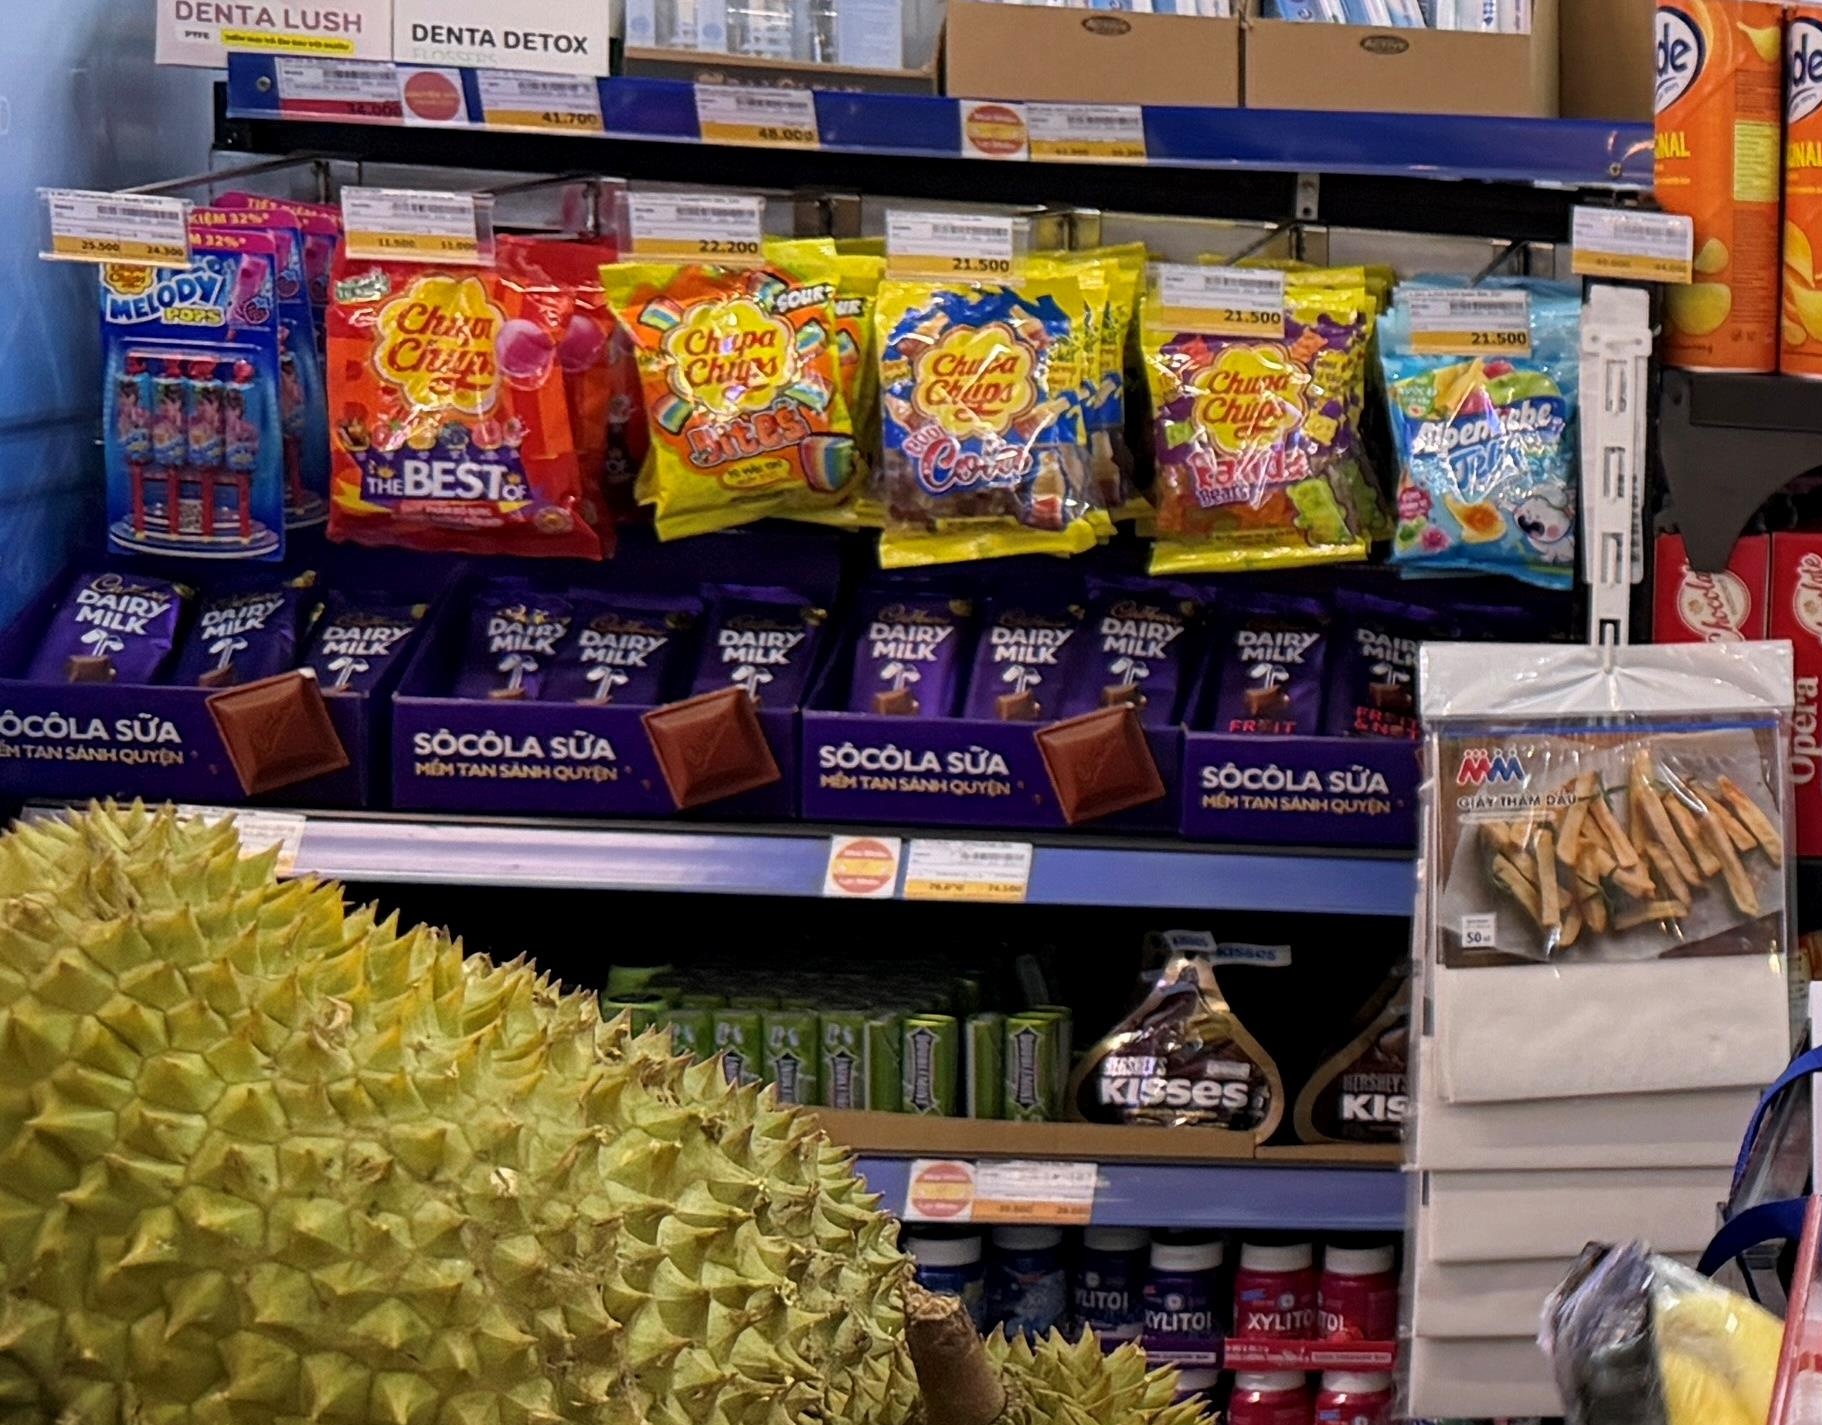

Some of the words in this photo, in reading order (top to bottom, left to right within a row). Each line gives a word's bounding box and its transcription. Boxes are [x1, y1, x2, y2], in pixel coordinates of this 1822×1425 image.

[284, 7, 364, 34] LUSH
[411, 23, 496, 48] DENTA
[502, 28, 588, 54] DETOX
[699, 240, 759, 255] 22.200
[952, 257, 1011, 273] 21.500
[106, 274, 224, 323] MELODY
[165, 307, 224, 326] POPS
[1223, 308, 1282, 326] 21.500
[684, 328, 776, 356] Chupa
[1470, 330, 1528, 347] 21.500
[686, 356, 779, 388] Chups
[932, 353, 1019, 378] Chupa
[925, 378, 1016, 407] Chups
[1207, 369, 1289, 398] Chupa
[367, 477, 404, 496] THE
[402, 459, 508, 500] BEST
[502, 484, 528, 501] OF
[75, 588, 172, 624] DAIRY
[201, 595, 286, 628] DAIRY
[75, 607, 150, 636] MILK
[201, 615, 266, 640] MILK
[488, 616, 569, 640] DAIRY
[1100, 616, 1185, 643] DAIRY
[323, 624, 416, 643] DAIRY
[578, 628, 669, 653] DAIRY
[718, 628, 806, 649] DAIRY
[868, 621, 955, 645] DAIRY
[990, 626, 1075, 648] DAIRY
[1236, 629, 1321, 649] DAIRY
[322, 639, 391, 656] MILK
[489, 635, 558, 656] MILK
[721, 646, 791, 666] MILK
[872, 641, 938, 662] MILK
[993, 643, 1059, 665] MILK
[1102, 637, 1168, 660] MILK
[1240, 645, 1305, 664] MILK
[580, 646, 648, 668] MILK
[0, 709, 110, 741] ÔCÔLA
[114, 711, 183, 745] SỮA
[26, 745, 64, 761] TAN
[413, 728, 546, 760] SÔCÔLA
[550, 729, 617, 762] SỮA
[818, 741, 941, 773] SÔCÔLA
[946, 744, 1010, 776] SỮA
[456, 762, 498, 778] TAN
[1201, 762, 1323, 793] SÔCÔLA
[1327, 765, 1390, 795] SỮA
[859, 776, 897, 792] TAN
[1241, 796, 1279, 812] TAN
[1466, 931, 1483, 944] 50
[1246, 1310, 1314, 1332] XYLITO
